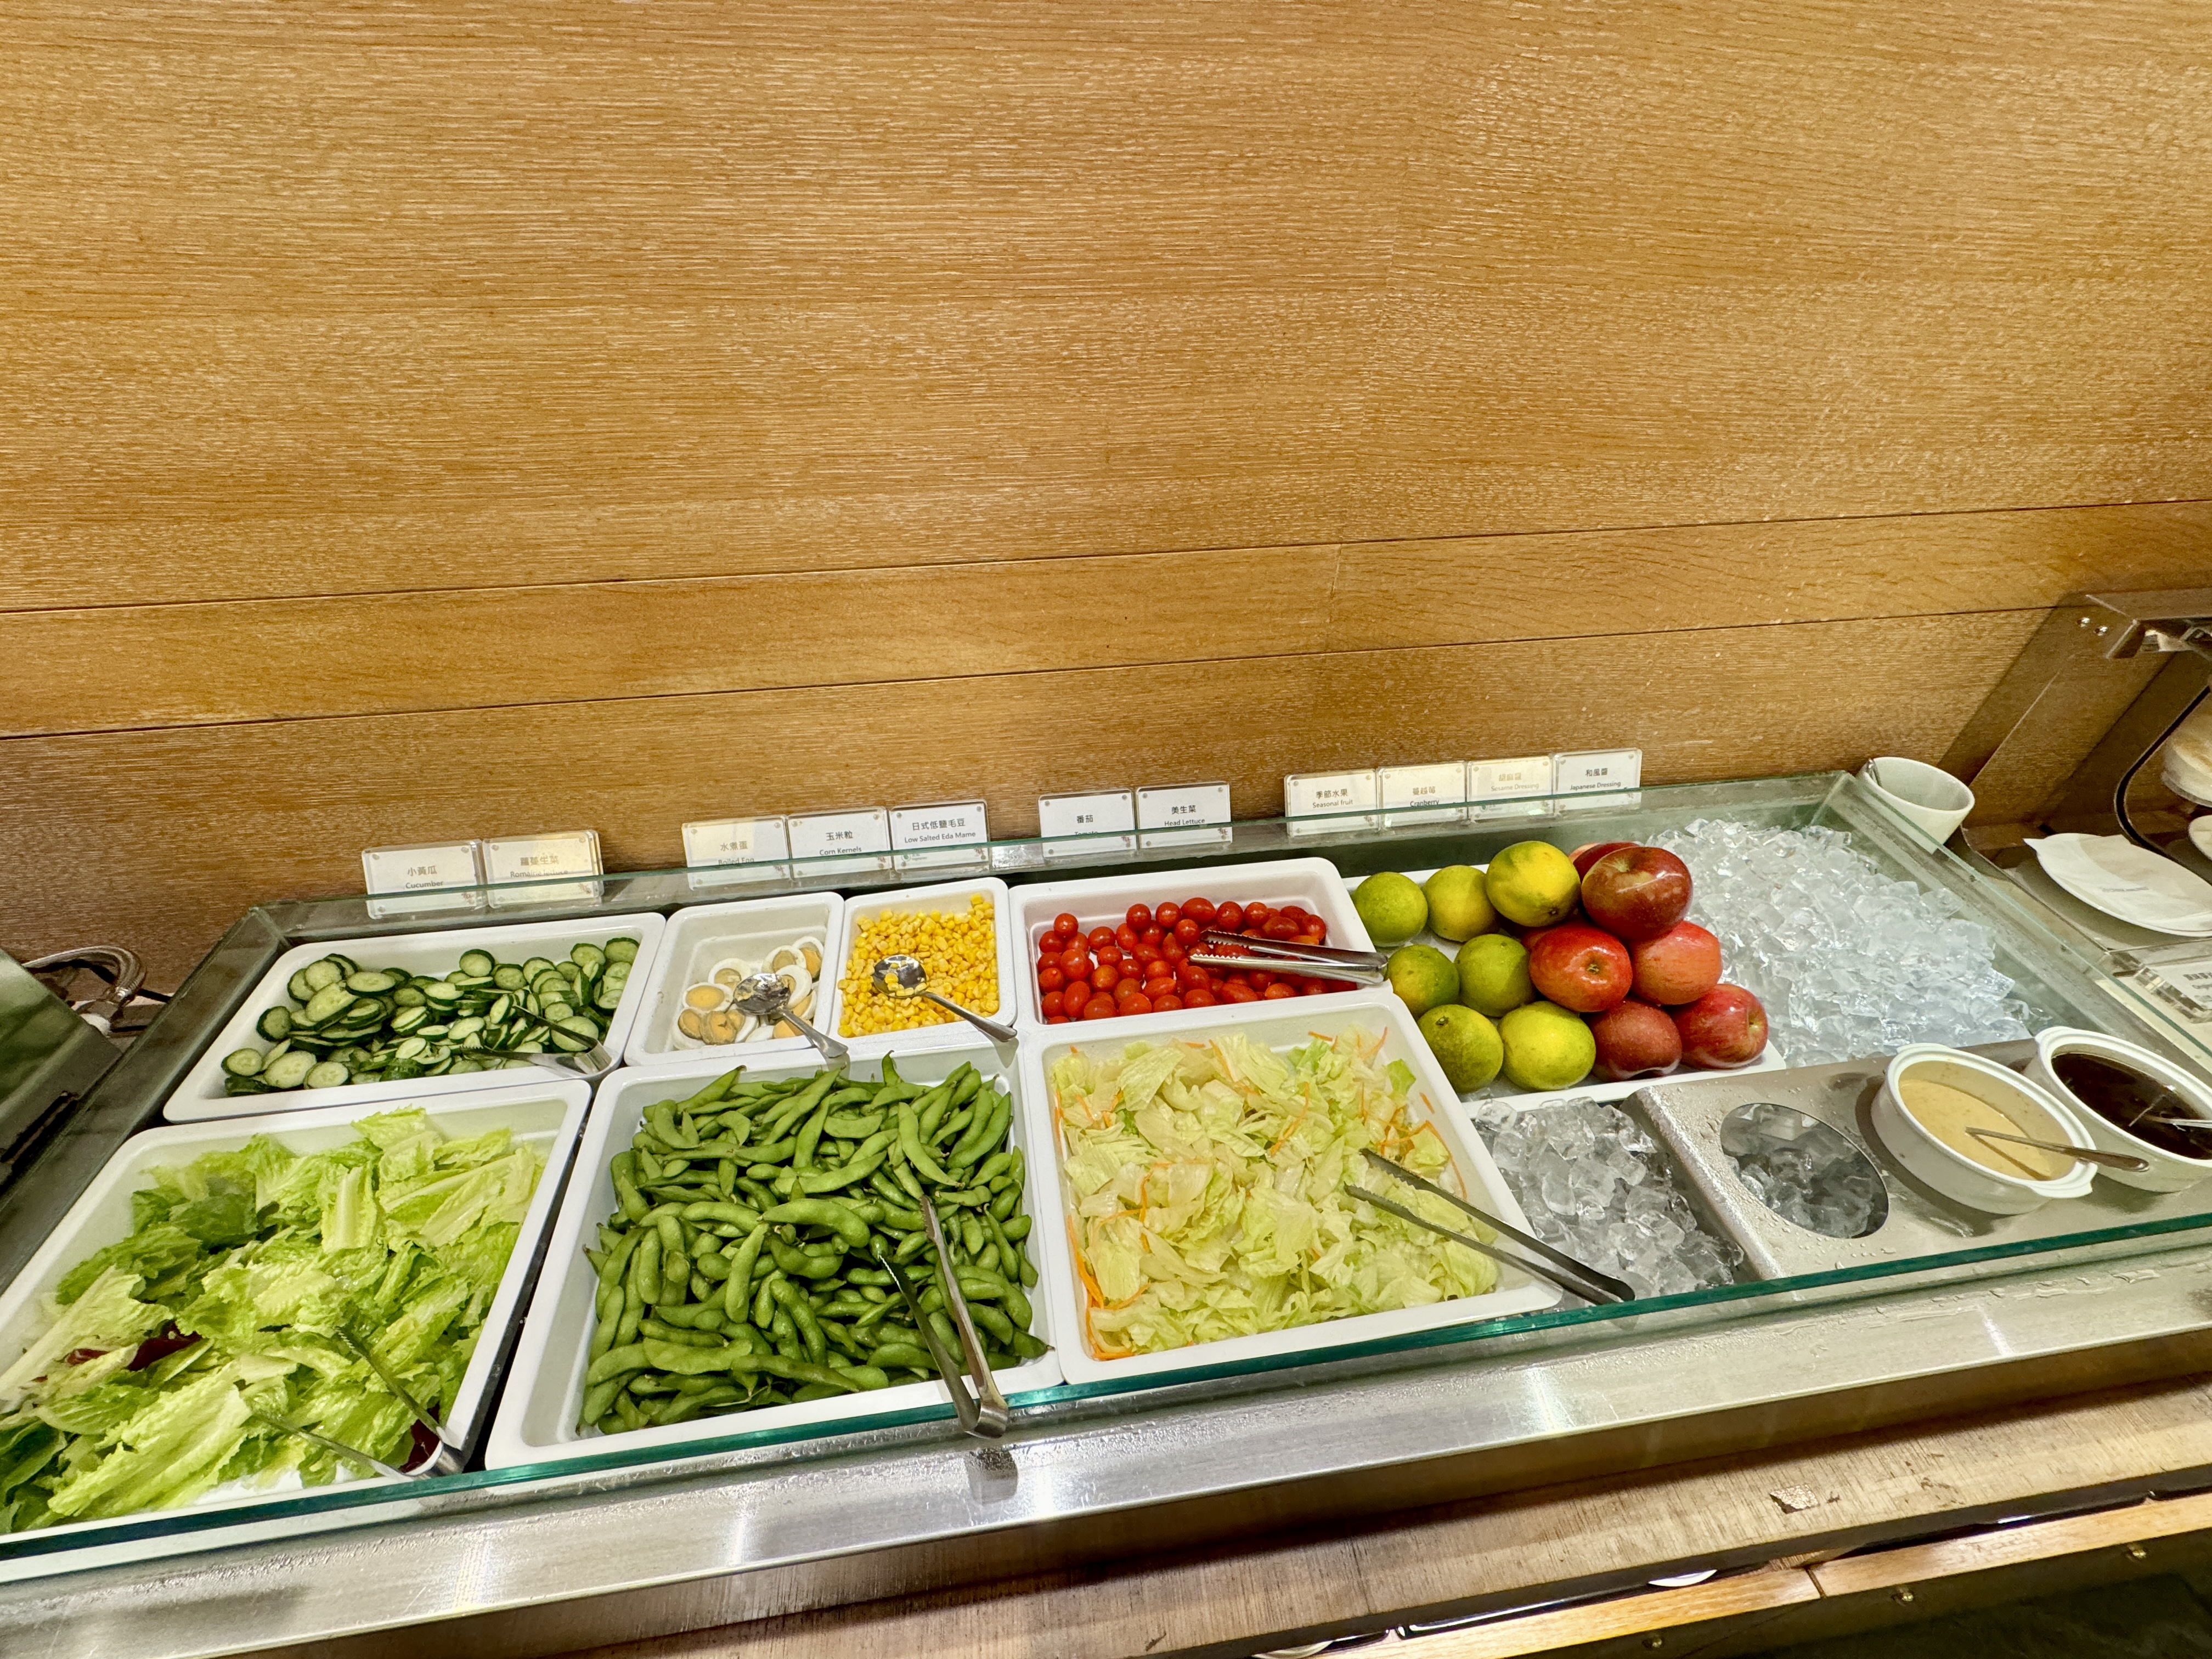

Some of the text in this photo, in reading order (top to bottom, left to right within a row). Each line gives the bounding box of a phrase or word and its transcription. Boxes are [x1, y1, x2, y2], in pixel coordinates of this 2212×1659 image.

[1316, 788, 1348, 799] 季節水果
[1312, 800, 1339, 808] Seasonal
[1171, 804, 1197, 815] 美生菜
[1076, 814, 1093, 824] 番茄
[912, 818, 966, 831] 日式低鹽毛豆
[825, 830, 854, 842] 玉米粒
[919, 834, 940, 842] Salted
[720, 840, 748, 851] 水煮蛋
[837, 845, 862, 854] Kernels
[718, 857, 740, 866] Boiled
[407, 865, 438, 877] 小黃瓜
[405, 880, 444, 889] Cucumber
